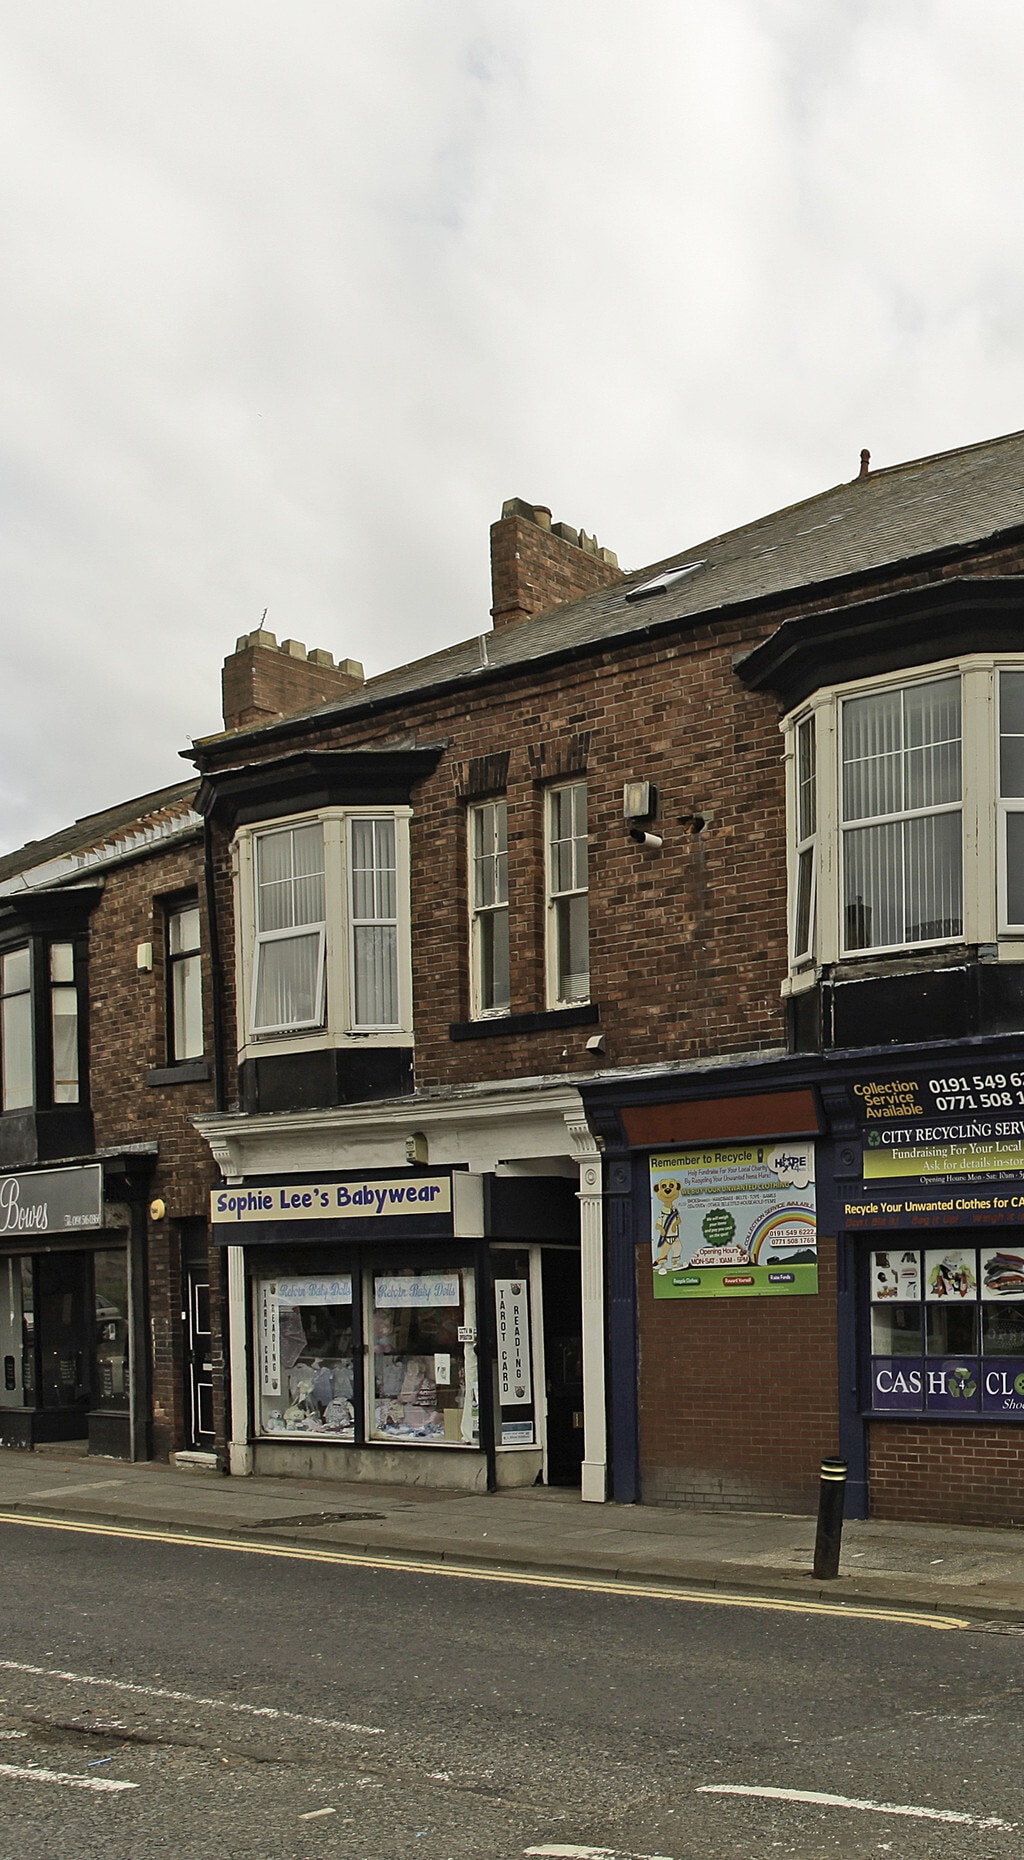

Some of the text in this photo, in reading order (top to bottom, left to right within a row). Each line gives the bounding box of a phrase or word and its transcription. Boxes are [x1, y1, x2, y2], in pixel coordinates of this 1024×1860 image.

[853, 1081, 919, 1096] Collection
[929, 1077, 971, 1094] 0191
[972, 1074, 1006, 1090] 549
[864, 1092, 914, 1106] Service
[936, 1095, 978, 1111] 0771
[980, 1092, 1013, 1108] 508
[866, 1103, 924, 1119] Available
[882, 1129, 913, 1144] CITY
[916, 1123, 992, 1141] RECYCLING
[651, 1151, 752, 1168] Remember to Recycle
[892, 1147, 947, 1160] Fundraising
[950, 1144, 967, 1155] For
[969, 1142, 993, 1154] Your
[996, 1140, 1021, 1152] Local
[923, 1160, 941, 1171] Ask
[943, 1158, 957, 1169] for
[960, 1156, 991, 1169] details
[0, 1177, 48, 1232] Bowes
[217, 1185, 440, 1220] Sophie Lee's Babywear
[845, 1202, 878, 1216] Recycle
[880, 1202, 902, 1213] Your
[905, 1199, 953, 1212] Unwanted
[956, 1198, 991, 1210] Clothes
[993, 1196, 1009, 1208] for
[744, 1212, 765, 1246] COLLECTION
[764, 1202, 785, 1215] SERVICE
[700, 1248, 721, 1256] Opening
[280, 1282, 352, 1300] Reborn Baby Dolls
[377, 1282, 456, 1301] Reborn Baby Dolls
[514, 1305, 522, 1379] READING
[876, 1370, 947, 1395] CASH
[958, 1379, 966, 1390] 4
